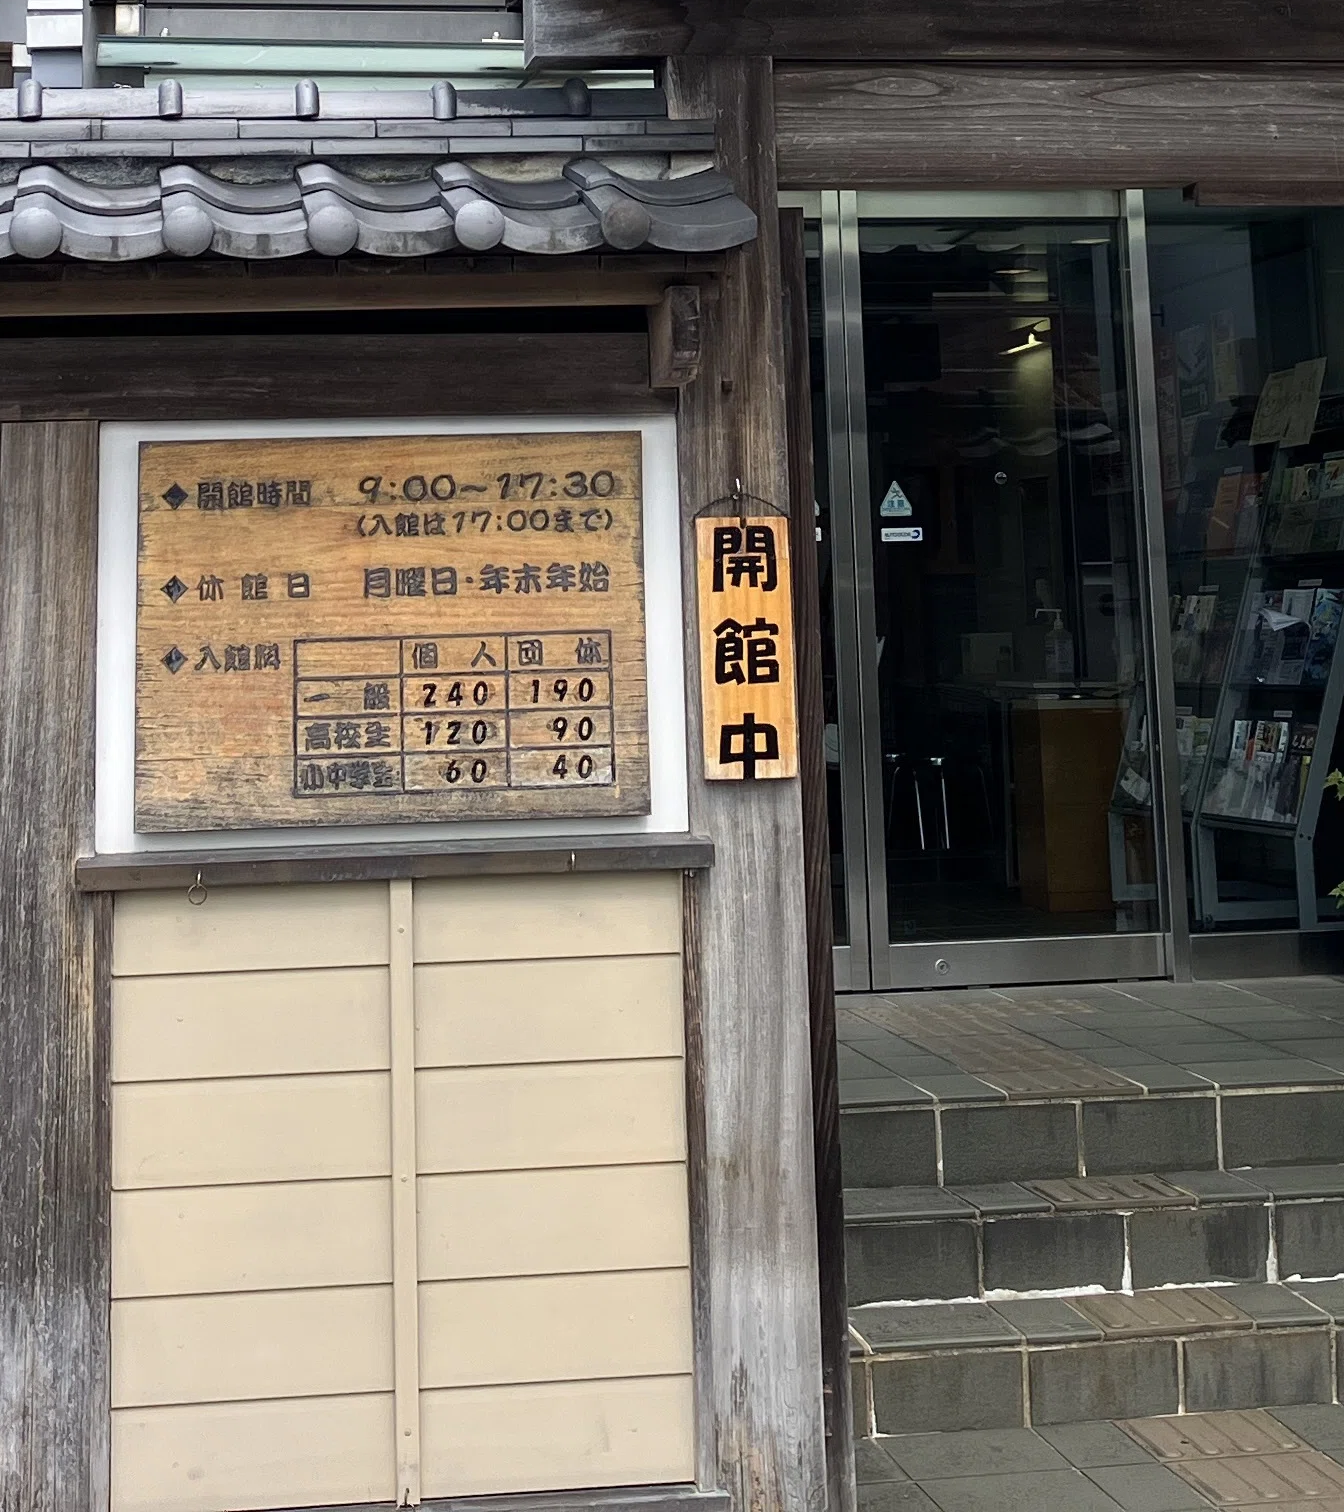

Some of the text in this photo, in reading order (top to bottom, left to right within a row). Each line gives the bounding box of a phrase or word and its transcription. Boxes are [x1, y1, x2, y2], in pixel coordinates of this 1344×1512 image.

[197, 480, 312, 510] 開館時間
[197, 573, 311, 602] 休館日
[193, 643, 281, 672] 入館料
[412, 638, 602, 669] 個人 団体
[712, 524, 780, 780] 開館中
[304, 677, 594, 710] 一般 240 190
[304, 716, 594, 752] 高校生 120 90
[445, 759, 488, 784] 60
[552, 754, 594, 780] 40
